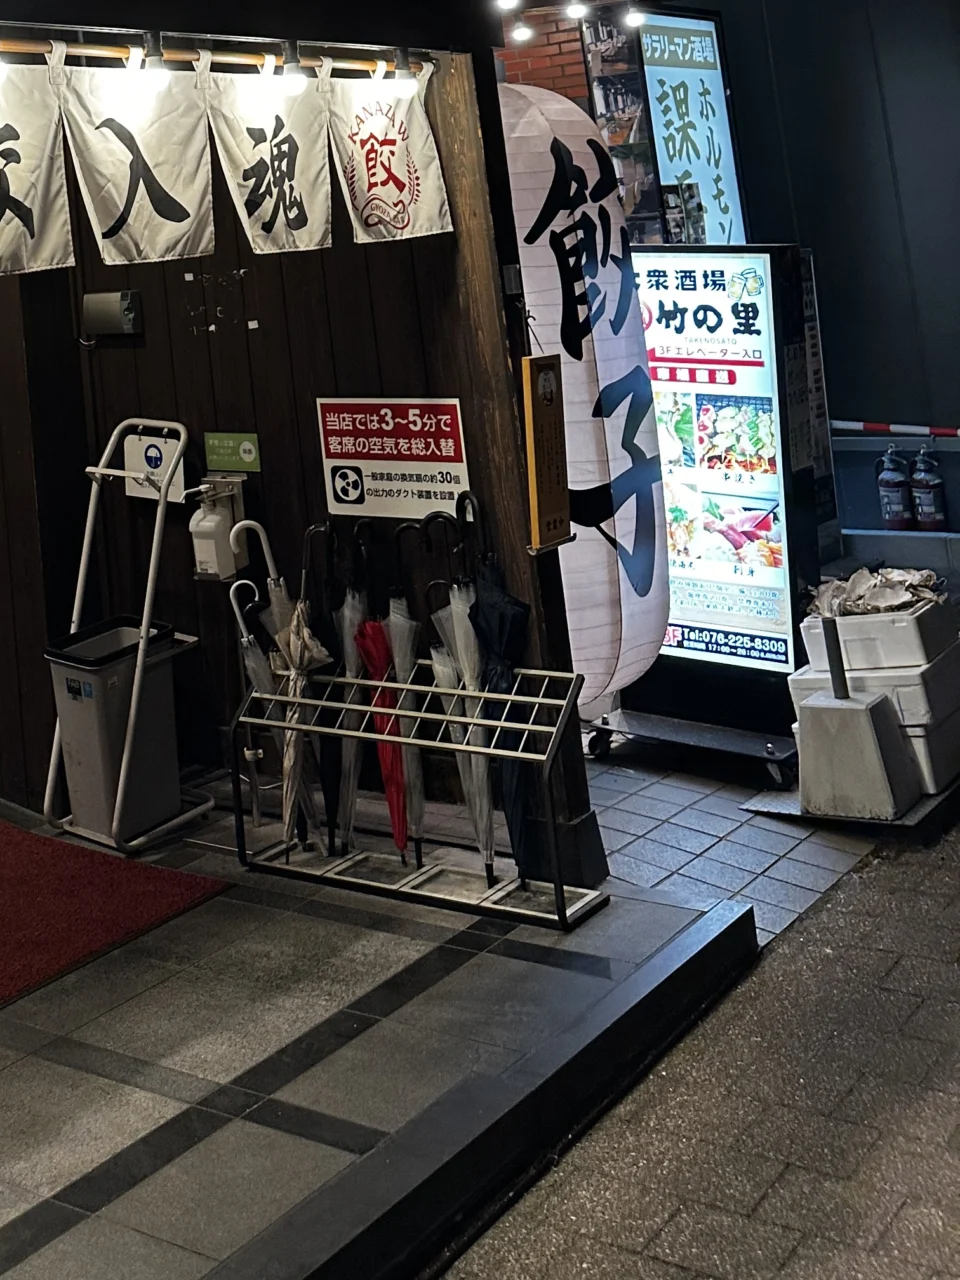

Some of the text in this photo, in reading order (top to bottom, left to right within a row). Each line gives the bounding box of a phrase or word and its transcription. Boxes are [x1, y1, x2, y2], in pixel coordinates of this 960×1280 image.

[642, 34, 716, 66] サラリーマン酒場
[348, 100, 410, 145] KANAZAW
[94, 117, 190, 239] 入
[242, 114, 309, 233] 魂
[359, 132, 407, 194] 餃
[697, 78, 734, 245] ホルモン
[656, 300, 762, 336] 竹の里
[683, 337, 738, 345] TAKENOSATO
[522, 136, 662, 597] 餃子
[328, 436, 455, 457] 客席の空気を総入替
[364, 471, 462, 486] 一般家庭の換気扇の約30倍
[366, 488, 460, 501] の出力のダクト装置を設置
